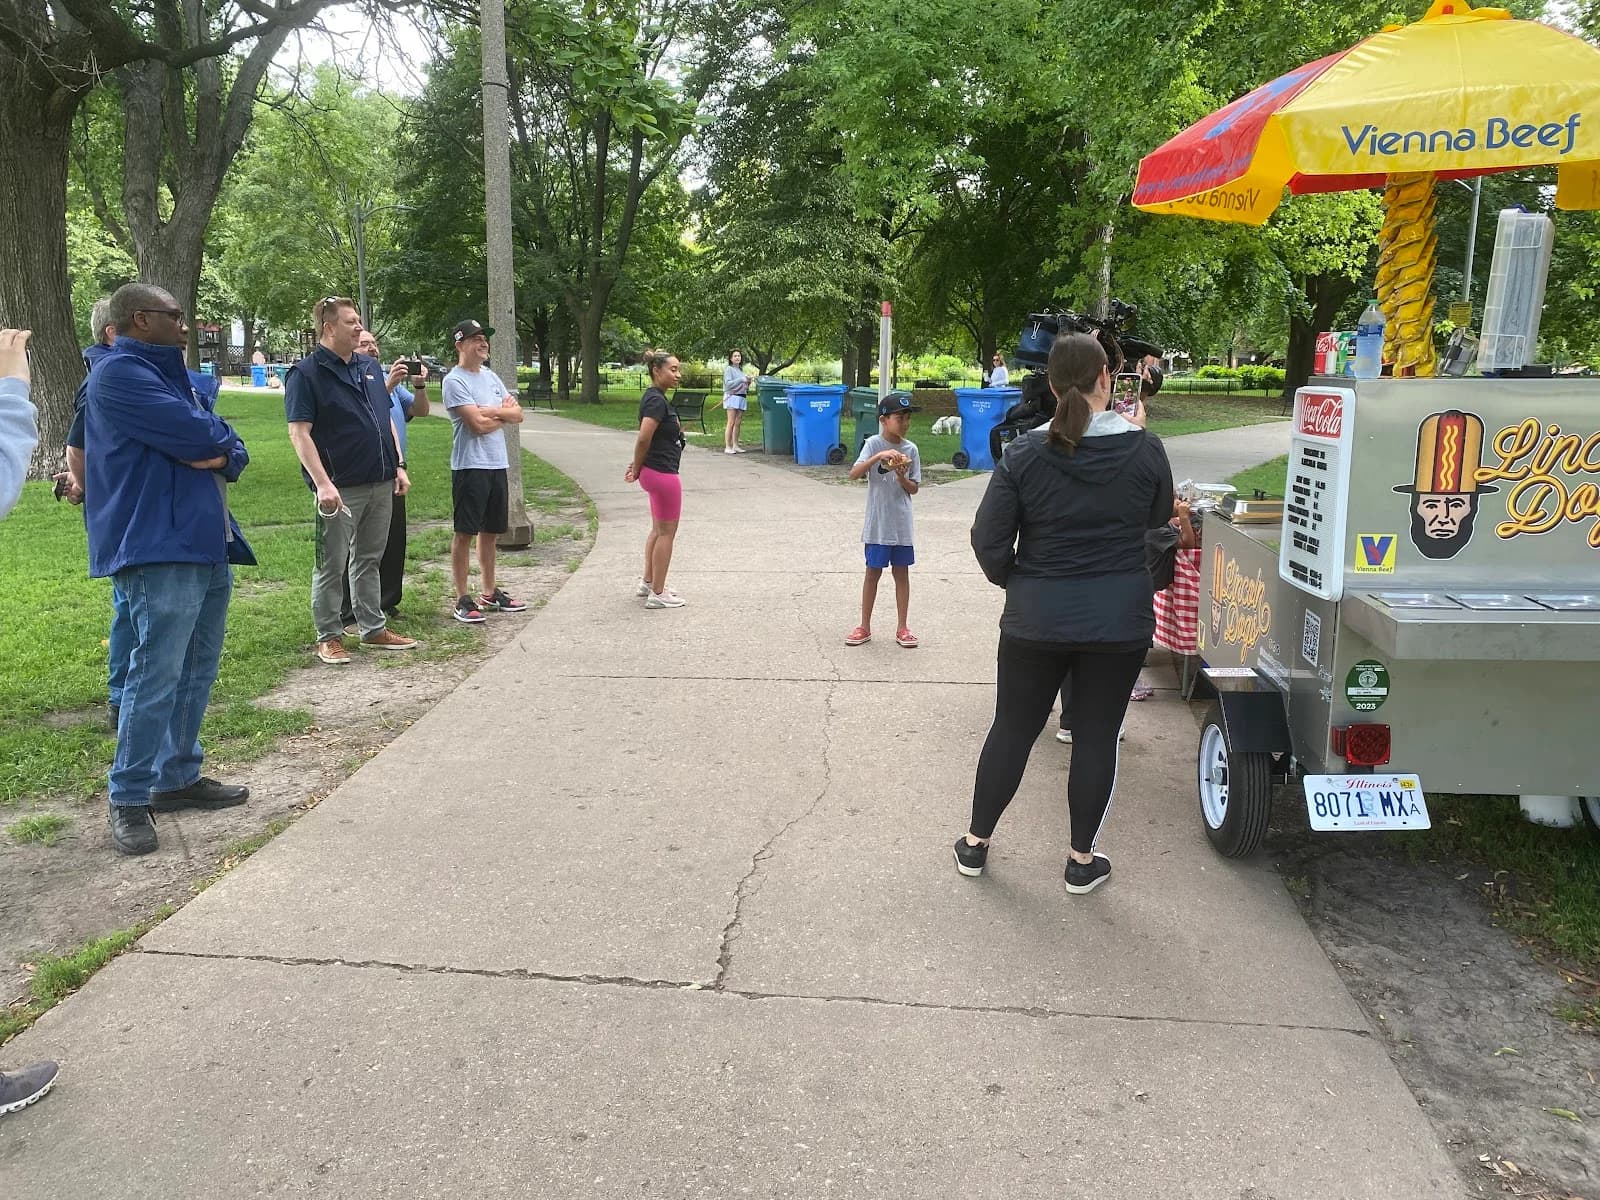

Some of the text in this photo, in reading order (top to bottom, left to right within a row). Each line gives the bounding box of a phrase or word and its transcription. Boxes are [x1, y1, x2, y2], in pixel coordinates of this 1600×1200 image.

[1341, 113, 1581, 156] Vienna Beef
[1495, 473, 1600, 548] Do
[1220, 557, 1266, 609] Lincoln
[1223, 601, 1271, 665] Dogs
[1355, 702, 1377, 711] 2023
[1313, 791, 1369, 818] 8071
[1379, 791, 1409, 817] MX
[1345, 777, 1392, 789] Illinois
